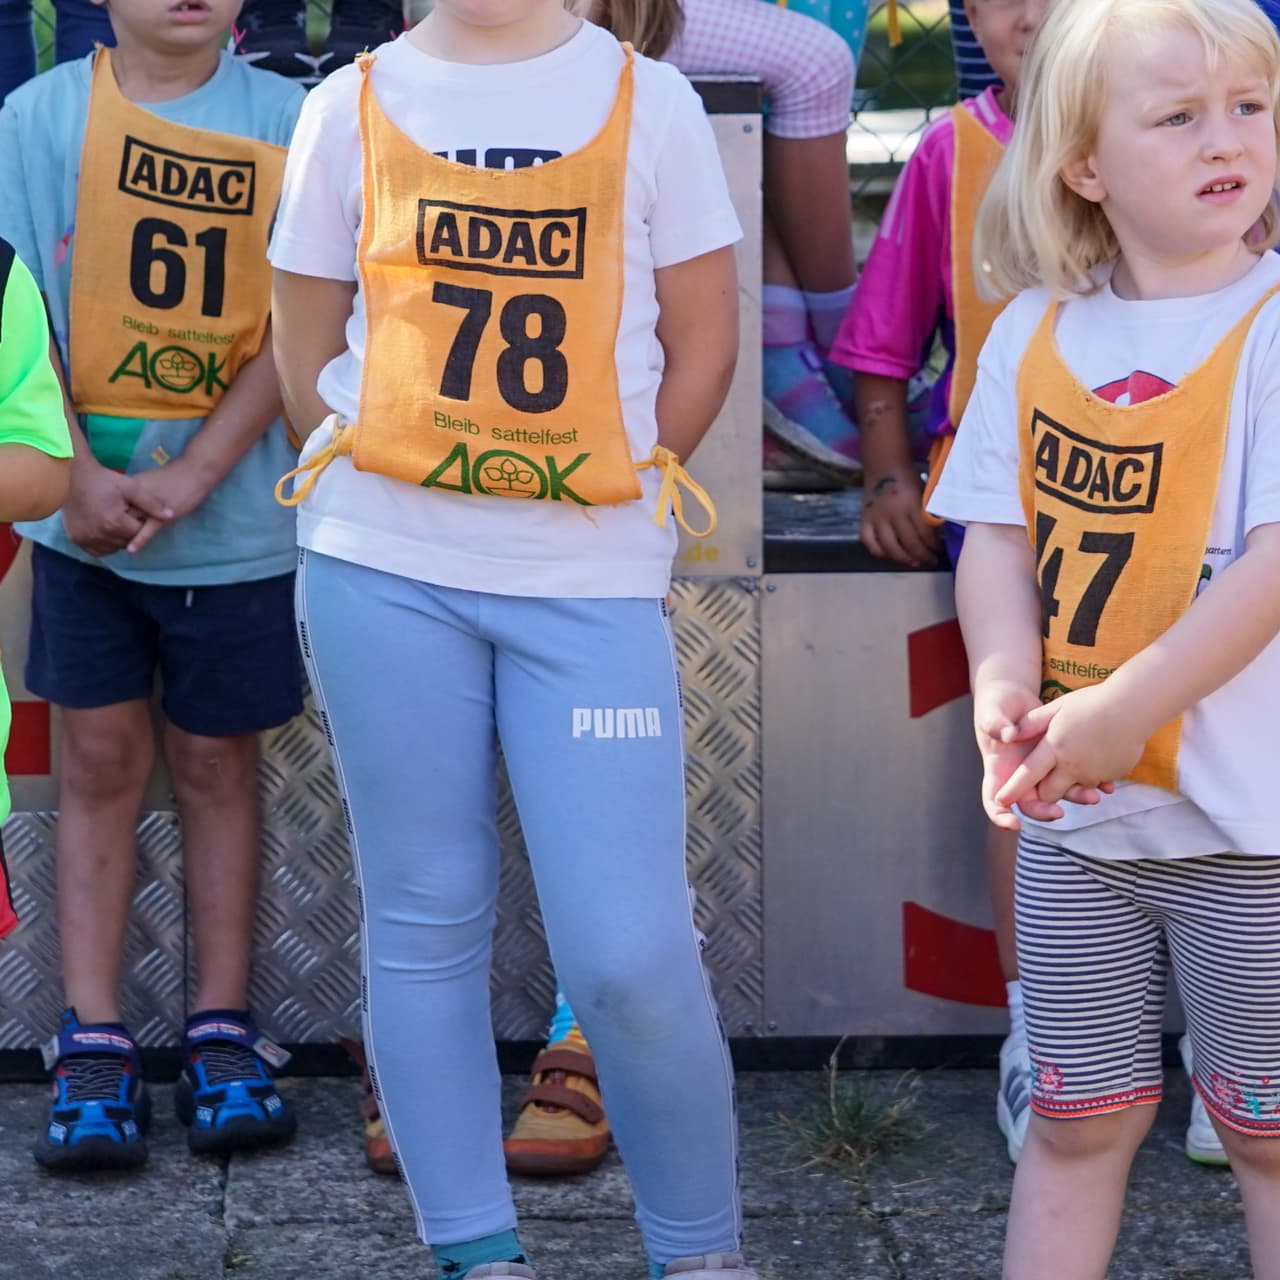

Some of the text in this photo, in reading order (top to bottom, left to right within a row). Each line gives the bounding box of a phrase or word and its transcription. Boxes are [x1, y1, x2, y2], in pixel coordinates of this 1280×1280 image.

[130, 151, 247, 206] ADAC
[128, 216, 229, 318] 61
[428, 211, 572, 267] ADAC
[107, 340, 231, 396] AOK
[431, 280, 570, 415] 78
[433, 410, 579, 446] Bleib sattelfest
[419, 441, 601, 506] AOK
[1034, 430, 1145, 503] ADAC
[572, 707, 662, 739] PUMA
